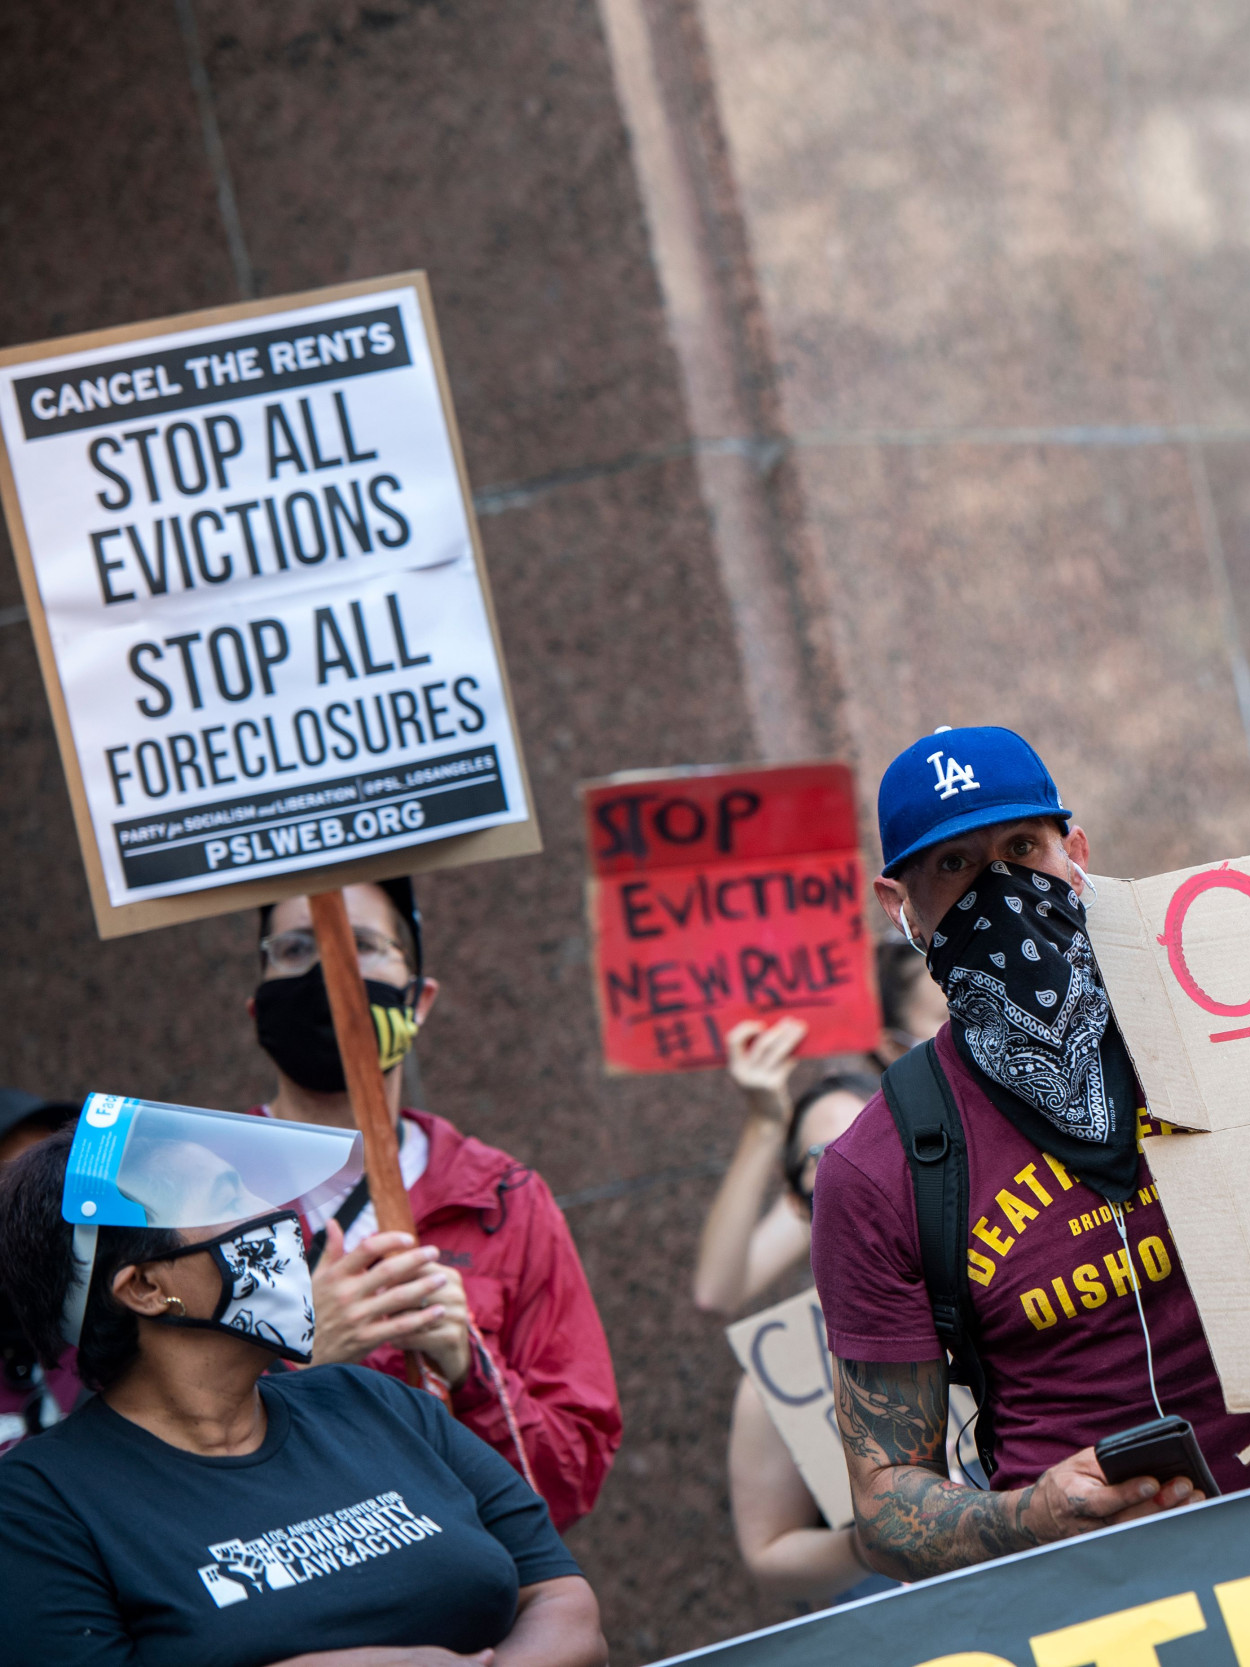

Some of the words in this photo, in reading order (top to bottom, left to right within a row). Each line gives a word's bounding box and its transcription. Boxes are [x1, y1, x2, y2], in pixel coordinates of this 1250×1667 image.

[31, 366, 182, 421] CANCEL
[186, 349, 264, 390] THE
[270, 323, 395, 374] RENTS
[88, 411, 243, 512] STOP
[266, 391, 378, 480] ALL
[90, 473, 411, 604] EVICTIONS
[128, 617, 290, 719] STOP
[313, 594, 431, 686] ALL
[105, 676, 486, 806] FORECLOSURES
[926, 751, 980, 800] LA
[204, 799, 426, 871] PSLWEB.ORG
[594, 788, 762, 859] STOP
[606, 955, 731, 1018] NEW
[738, 940, 850, 1008] RULE
[262, 1528, 288, 1545] LOS
[286, 1513, 337, 1537] ANGELES
[334, 1498, 378, 1522] CENTER
[375, 1490, 403, 1510] FOR
[271, 1501, 416, 1564] COMMUNITY
